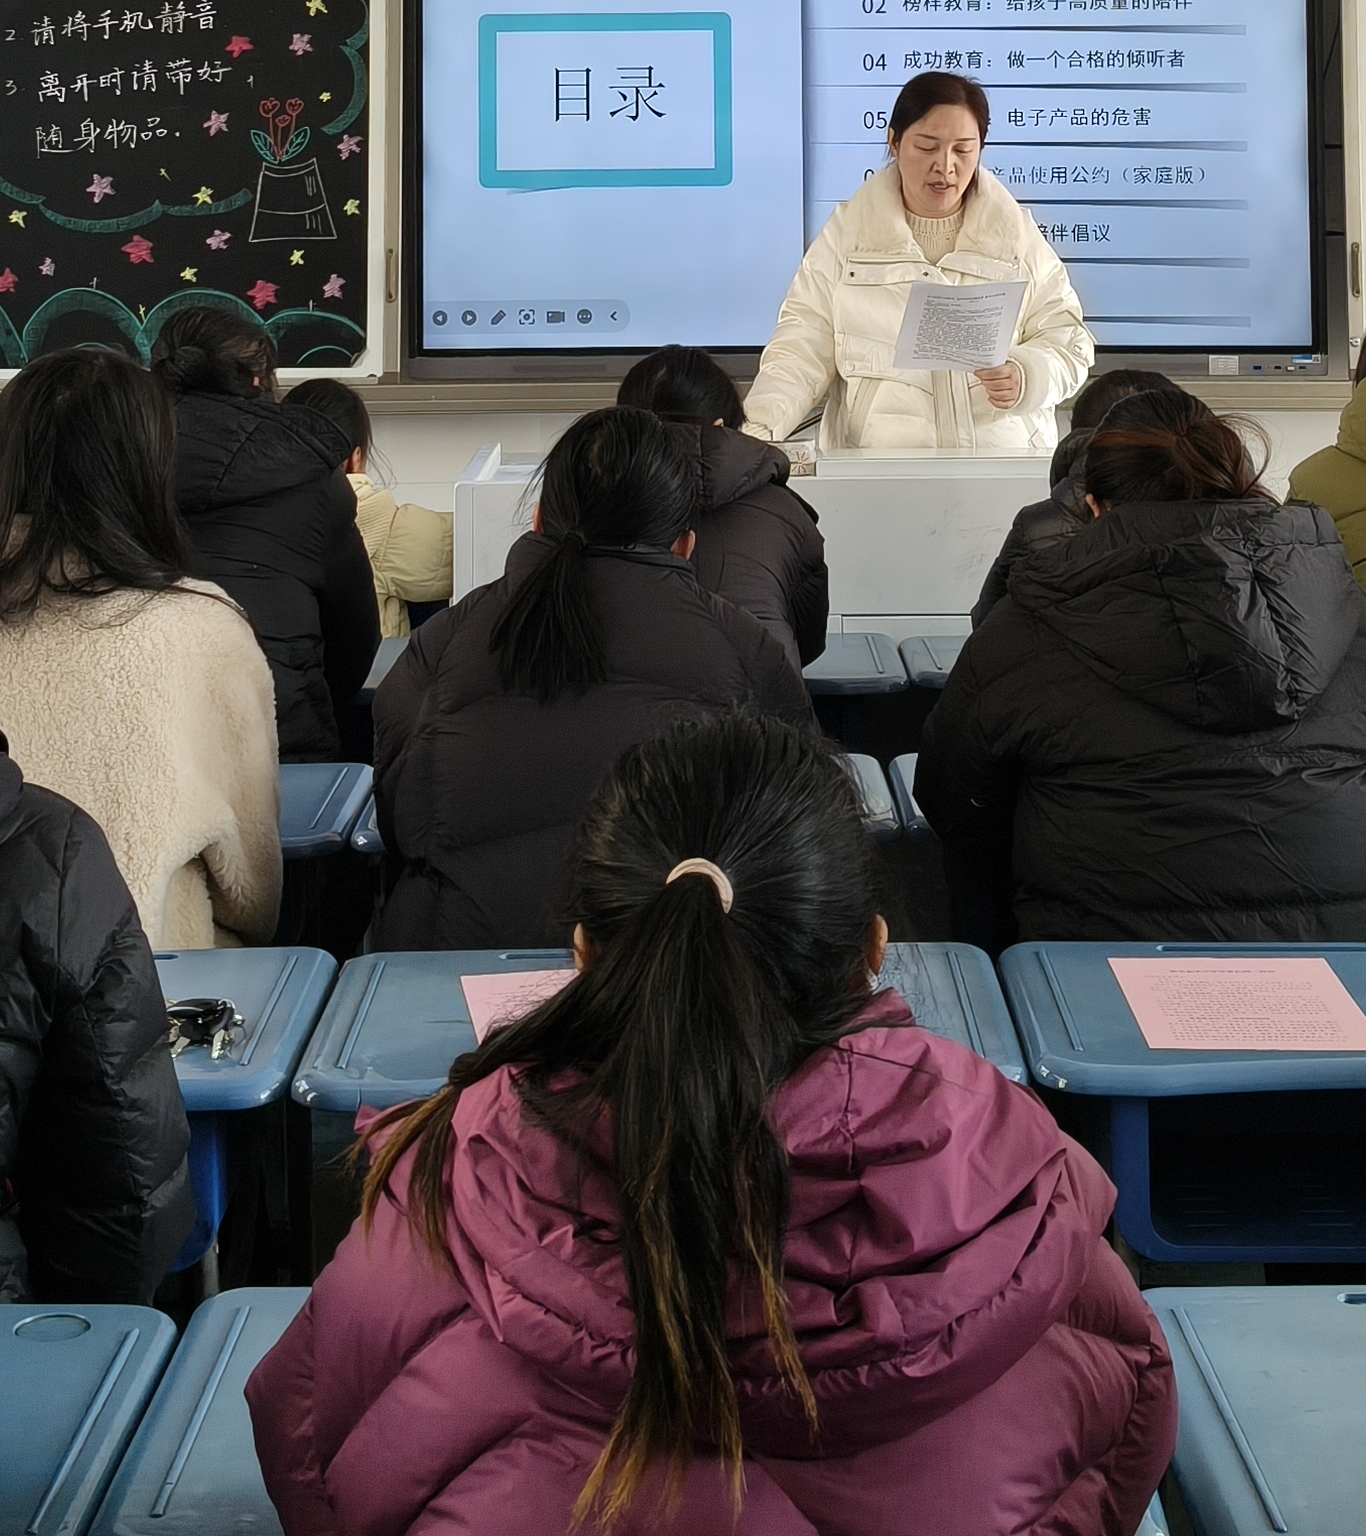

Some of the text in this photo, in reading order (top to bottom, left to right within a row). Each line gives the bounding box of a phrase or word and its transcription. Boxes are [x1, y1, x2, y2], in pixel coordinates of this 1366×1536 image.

[863, 49, 1185, 71] 04 成功教育：做一个合格的倾听者
[554, 65, 666, 123] 目录
[863, 111, 887, 129] 05
